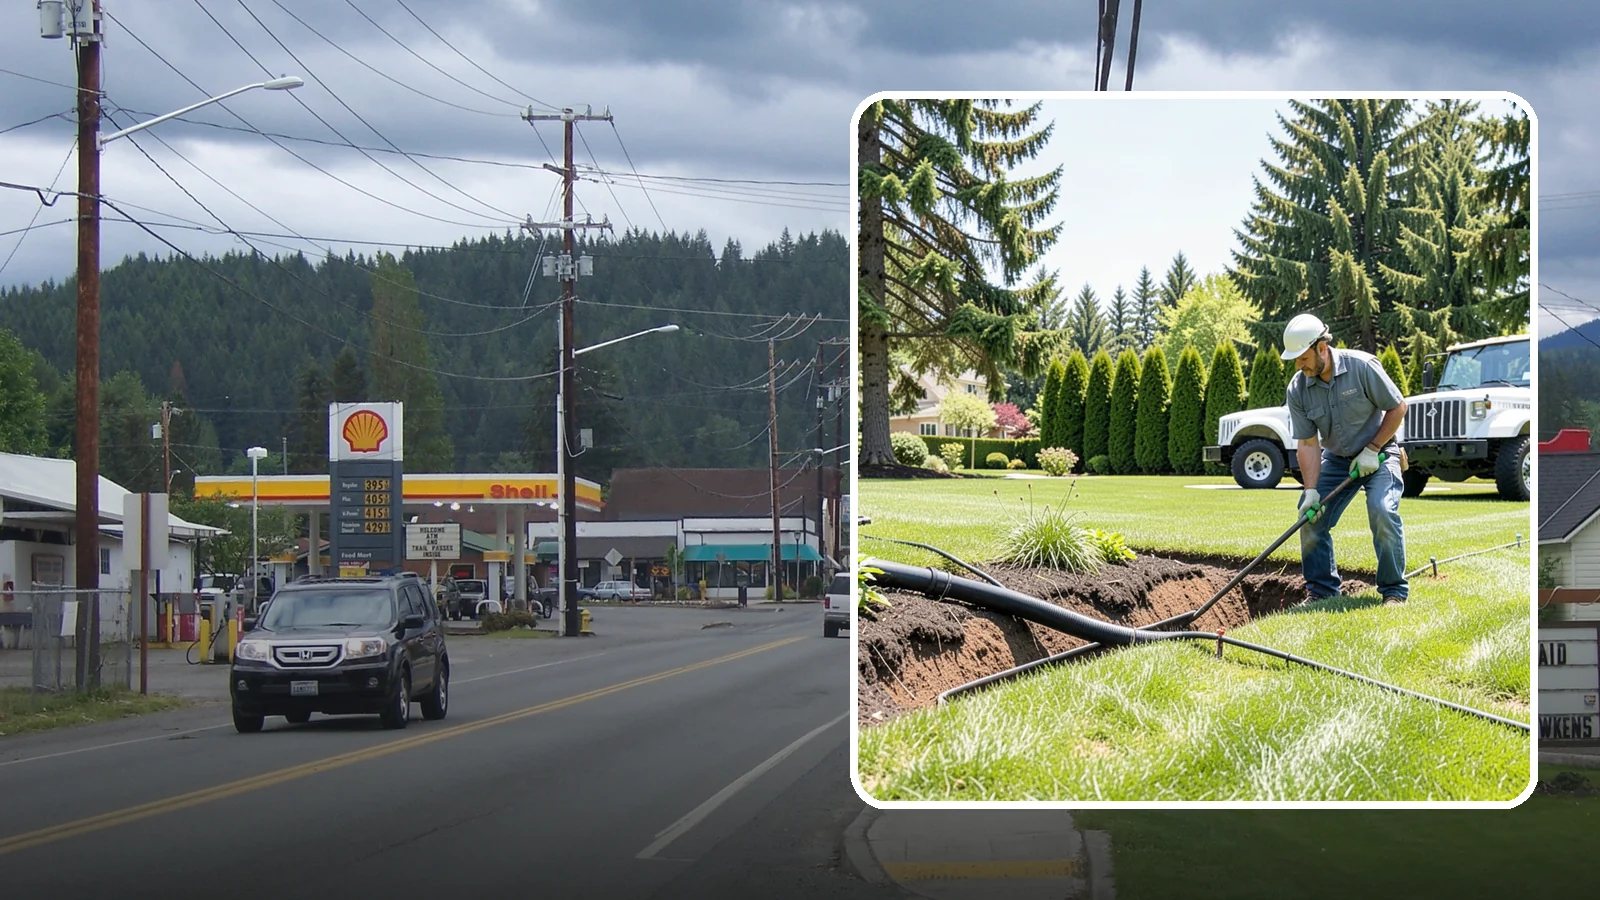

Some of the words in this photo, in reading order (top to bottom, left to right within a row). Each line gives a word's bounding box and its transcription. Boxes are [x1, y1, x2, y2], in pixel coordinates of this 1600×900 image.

[366, 480, 383, 490] 395
[490, 484, 547, 498] Shell
[366, 494, 383, 504] 405
[366, 508, 383, 518] 415
[366, 522, 383, 532] 429
[1538, 643, 1566, 665] AID
[1539, 716, 1592, 738] WKENS
